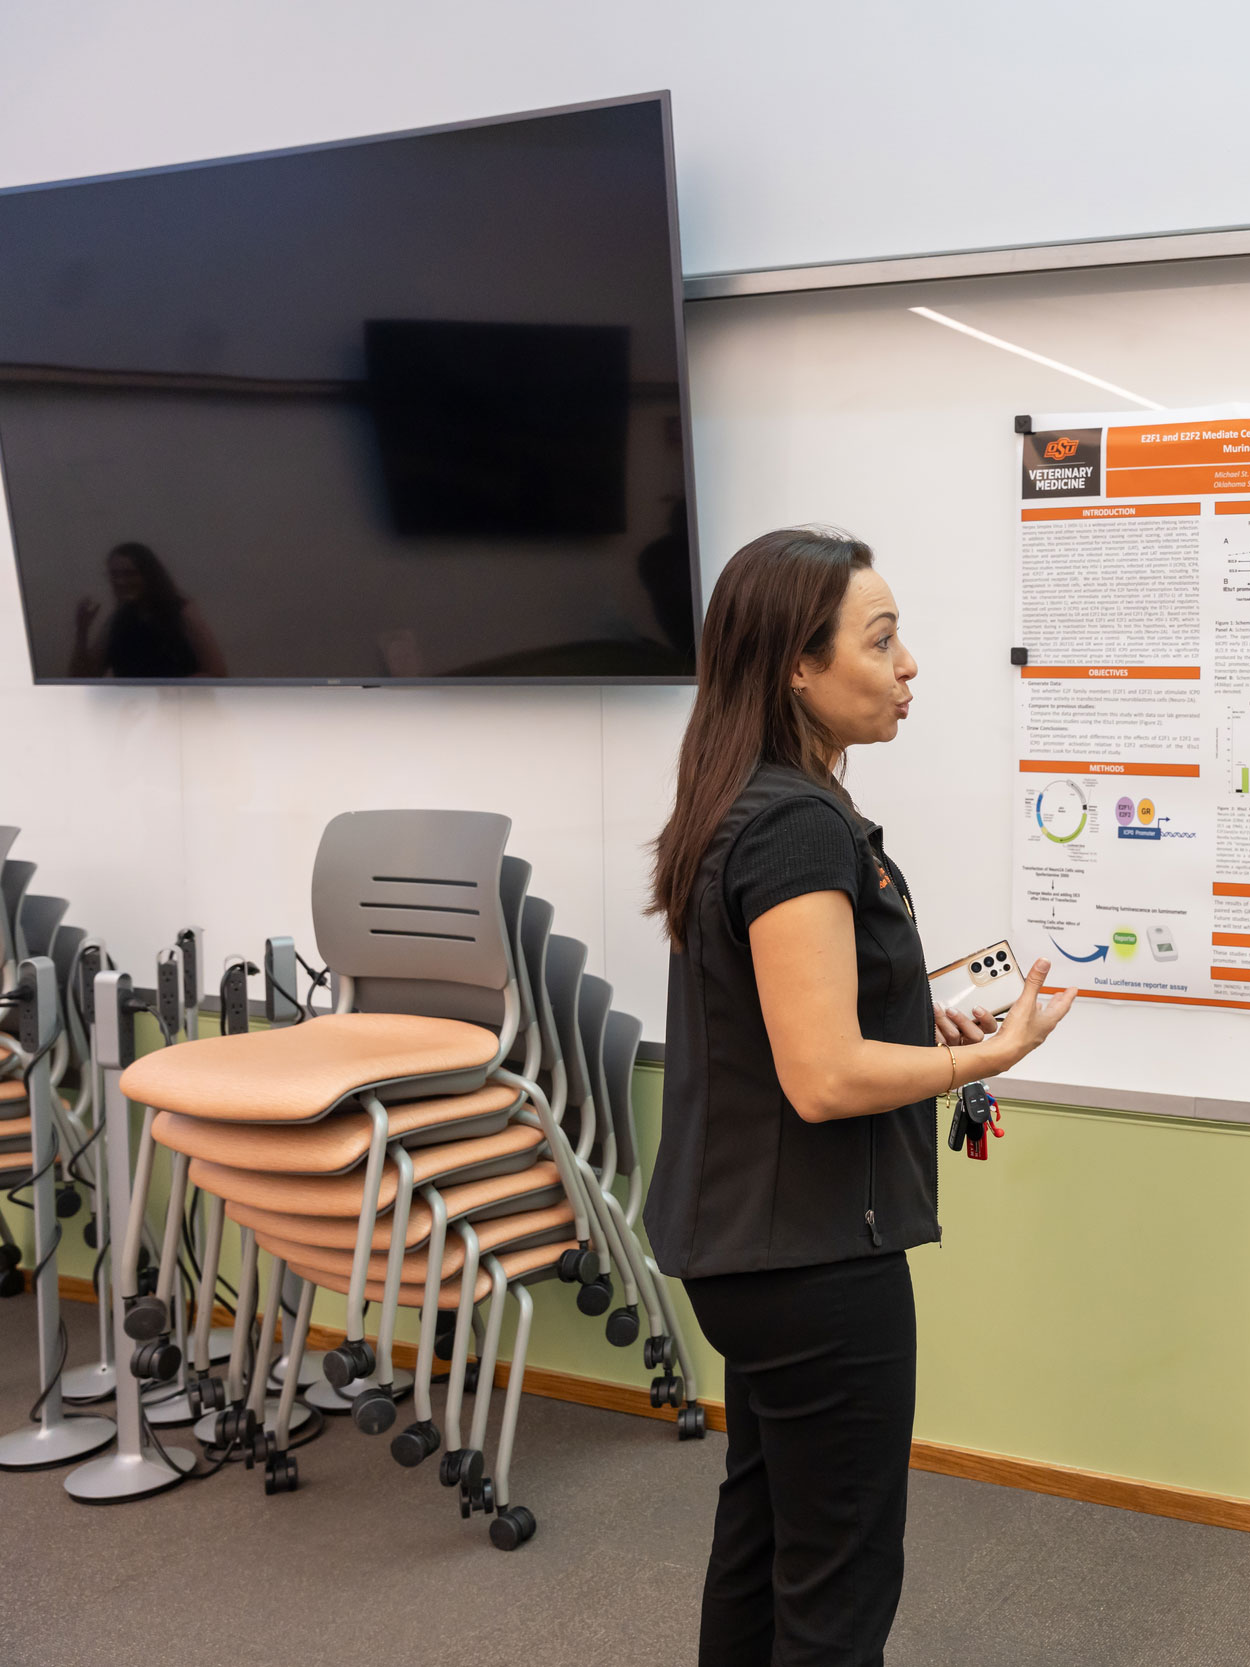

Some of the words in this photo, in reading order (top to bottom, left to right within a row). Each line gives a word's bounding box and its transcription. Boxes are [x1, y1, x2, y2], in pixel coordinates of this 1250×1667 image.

[1140, 433, 1160, 443] E2F1
[1162, 432, 1179, 442] and
[1180, 432, 1200, 440] E2F2
[1202, 430, 1238, 439] Mediate
[1044, 436, 1079, 460] OSU
[1029, 466, 1093, 480] VETERINARY
[1036, 478, 1085, 490] MEDICINE
[1082, 508, 1136, 516] INTRODUCTION
[1088, 669, 1128, 677] OBJECTIVES
[1090, 764, 1124, 772] METHODS
